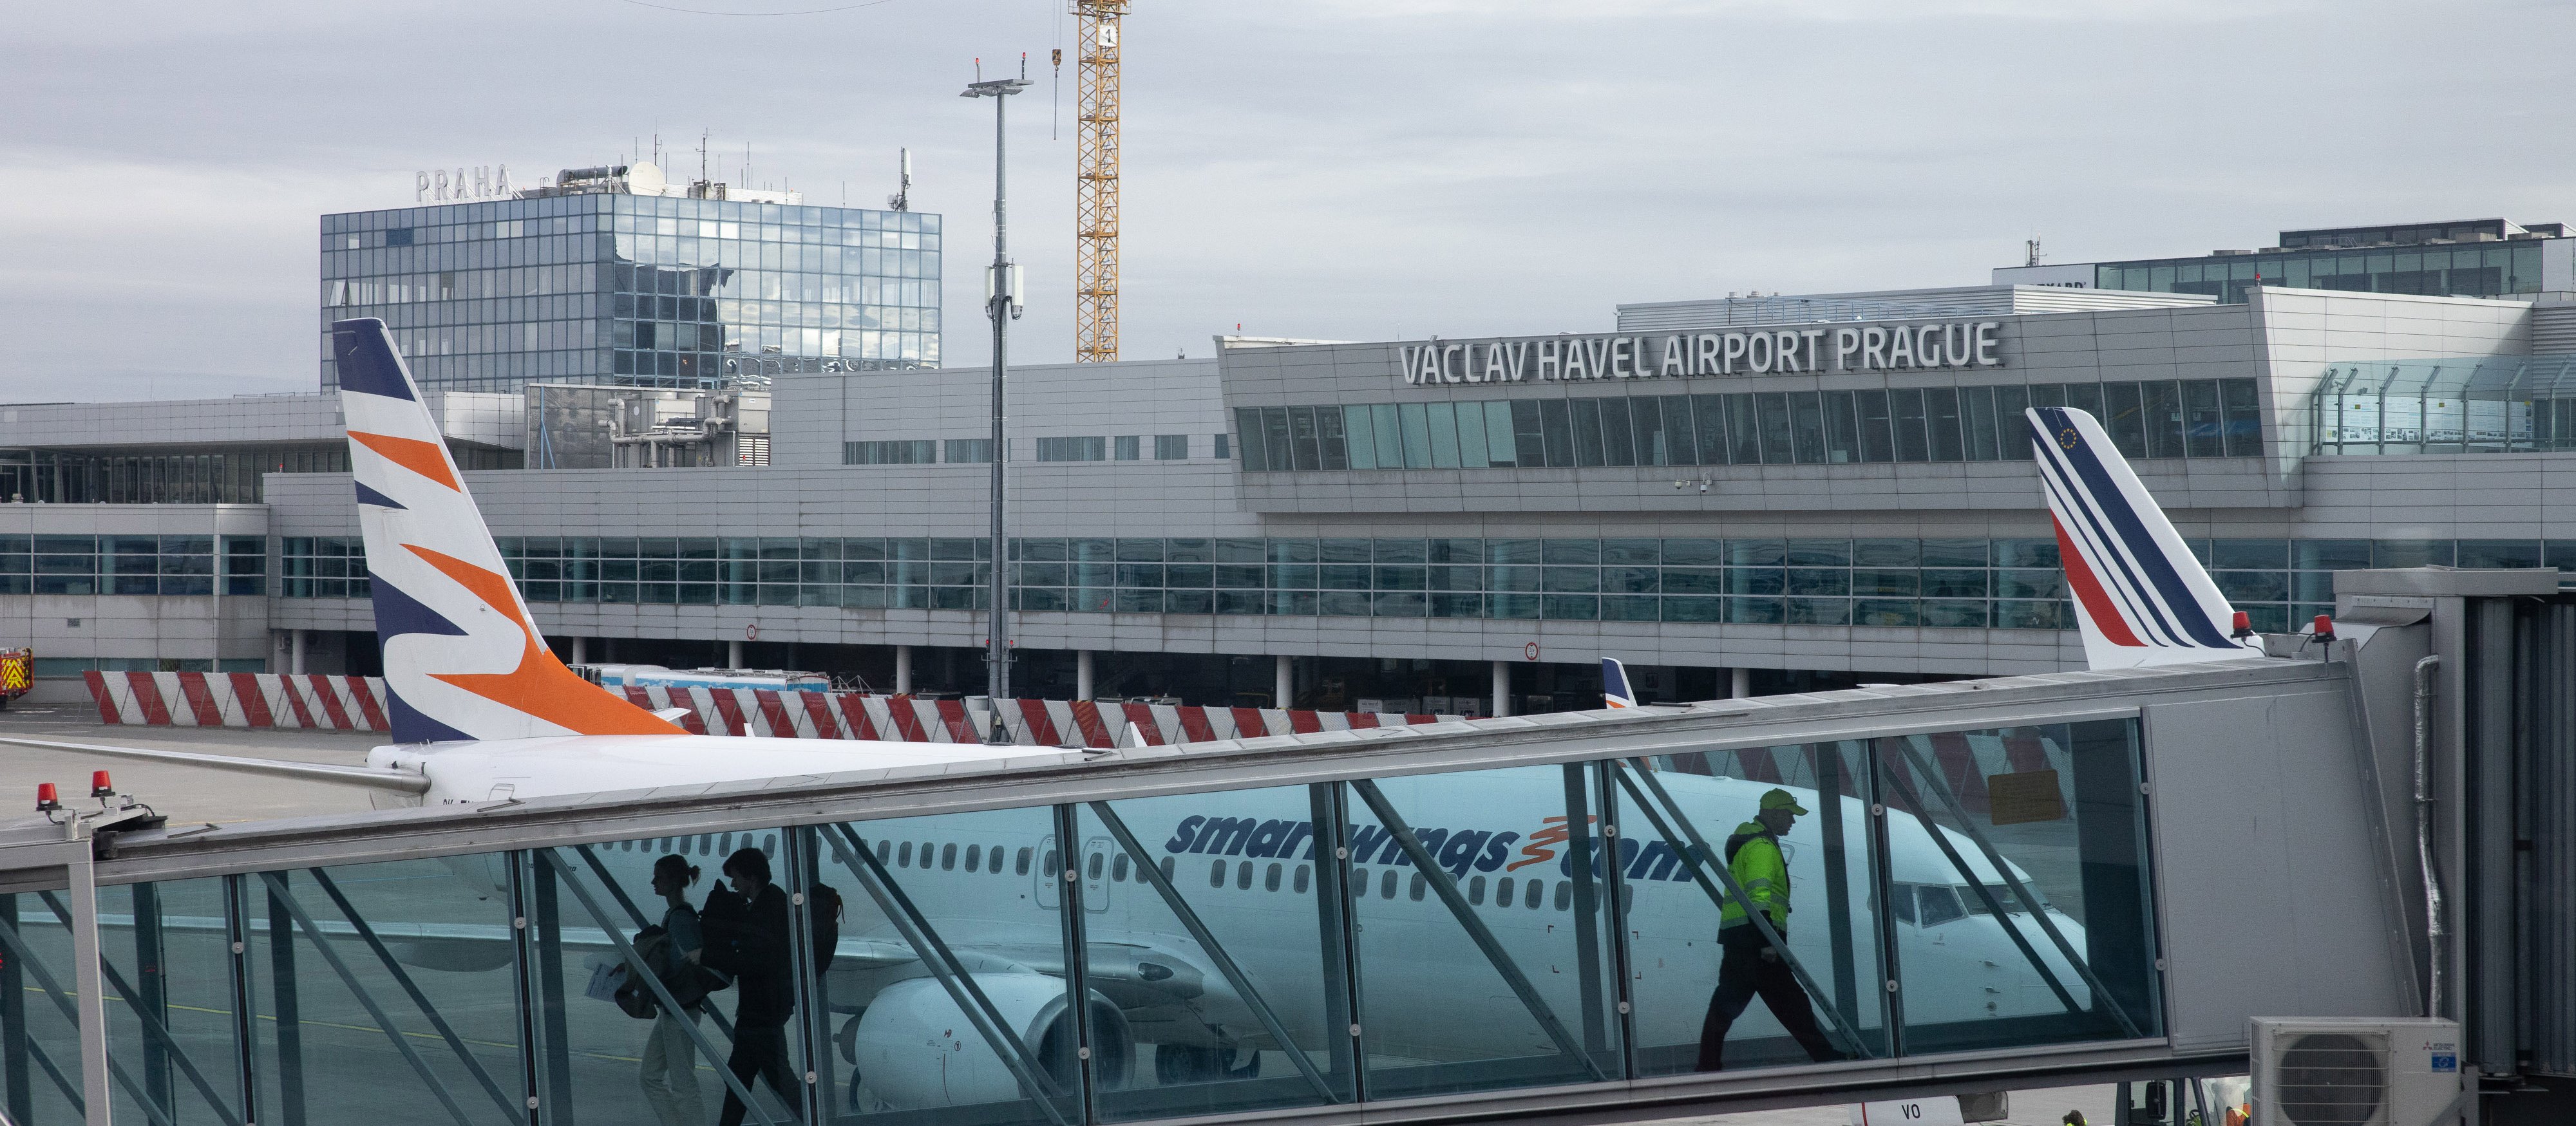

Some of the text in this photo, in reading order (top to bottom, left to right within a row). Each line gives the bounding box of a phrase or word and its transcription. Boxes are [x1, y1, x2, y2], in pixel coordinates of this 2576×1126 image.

[416, 164, 511, 202] PRAHA
[1538, 337, 1653, 380] HAVEL
[1661, 329, 1825, 376] AIRPORT
[1837, 322, 2000, 370] PRAGUE
[1164, 814, 1520, 881] smarwings
